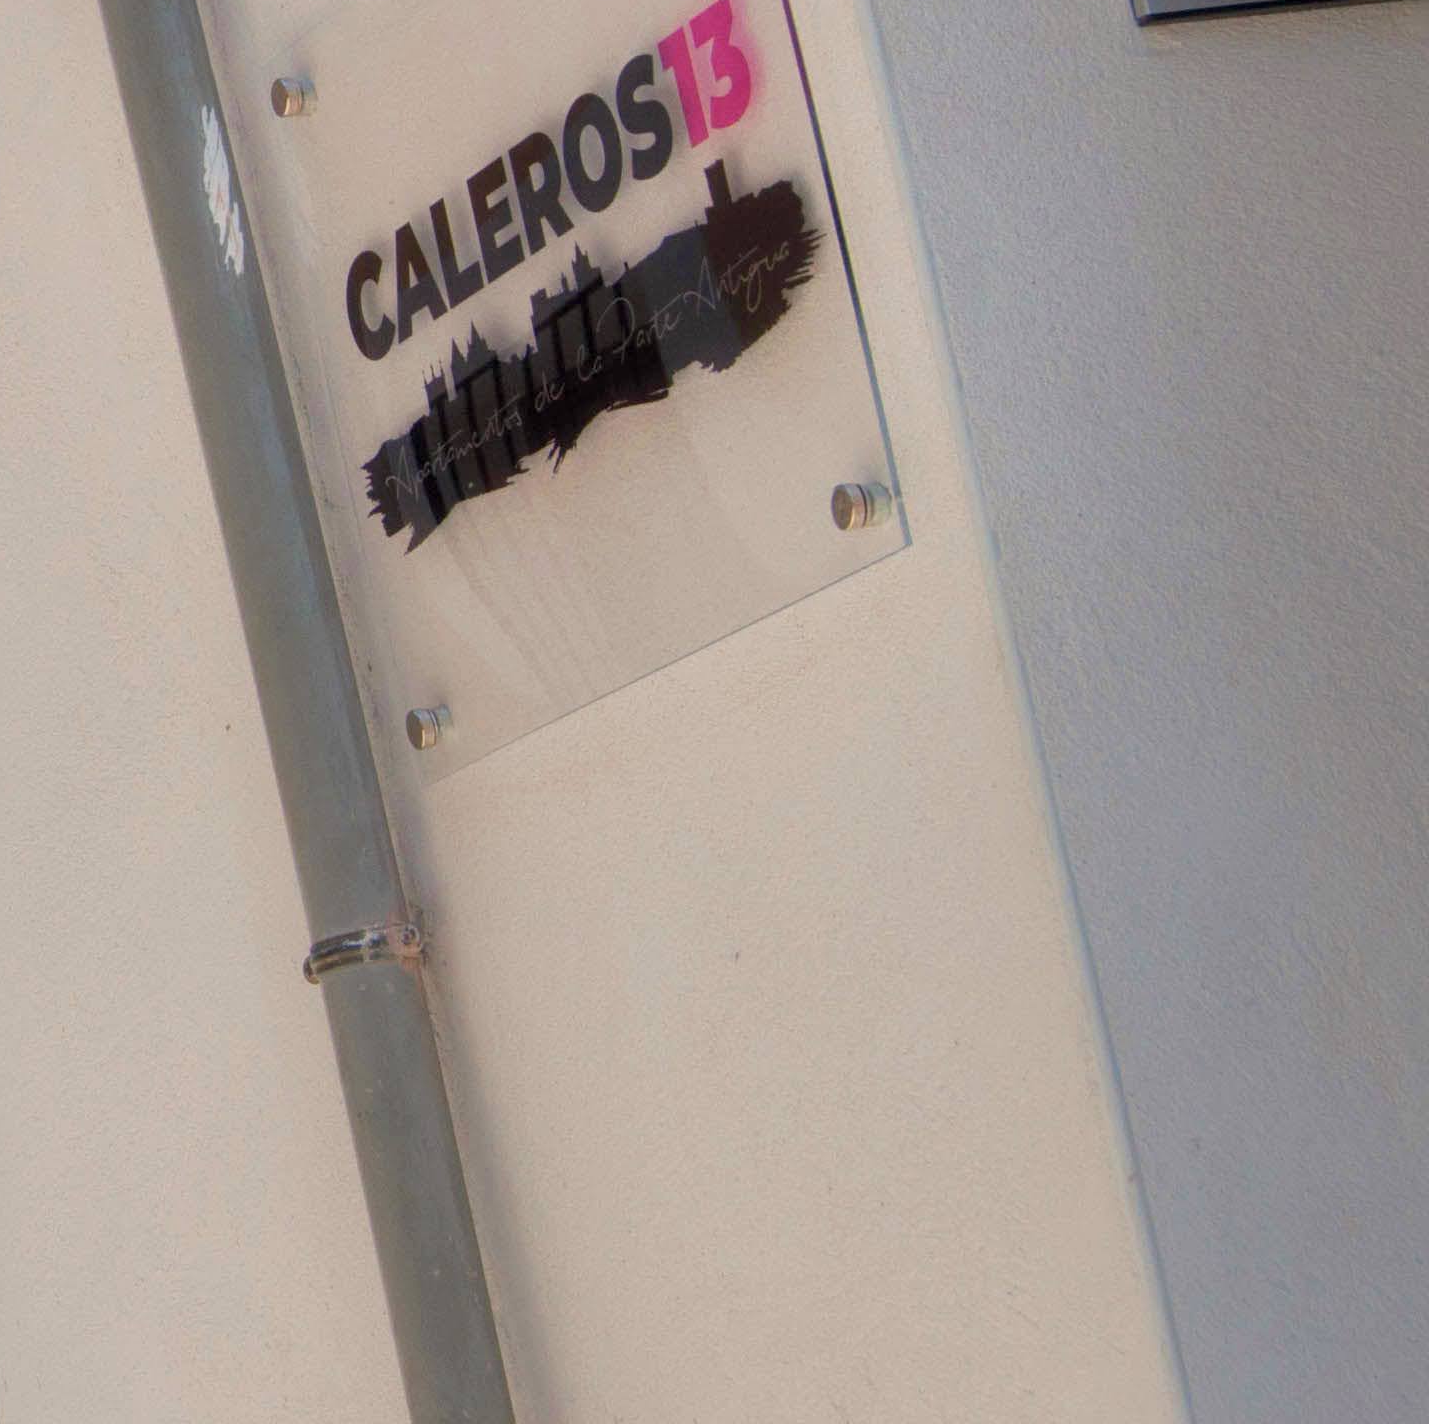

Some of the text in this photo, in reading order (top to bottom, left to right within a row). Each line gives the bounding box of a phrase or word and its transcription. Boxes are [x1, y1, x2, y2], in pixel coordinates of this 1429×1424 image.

[385, 394, 523, 504] Apartamentos
[534, 370, 566, 413] de
[596, 294, 685, 364] Parte
[684, 240, 790, 317] Antigua
